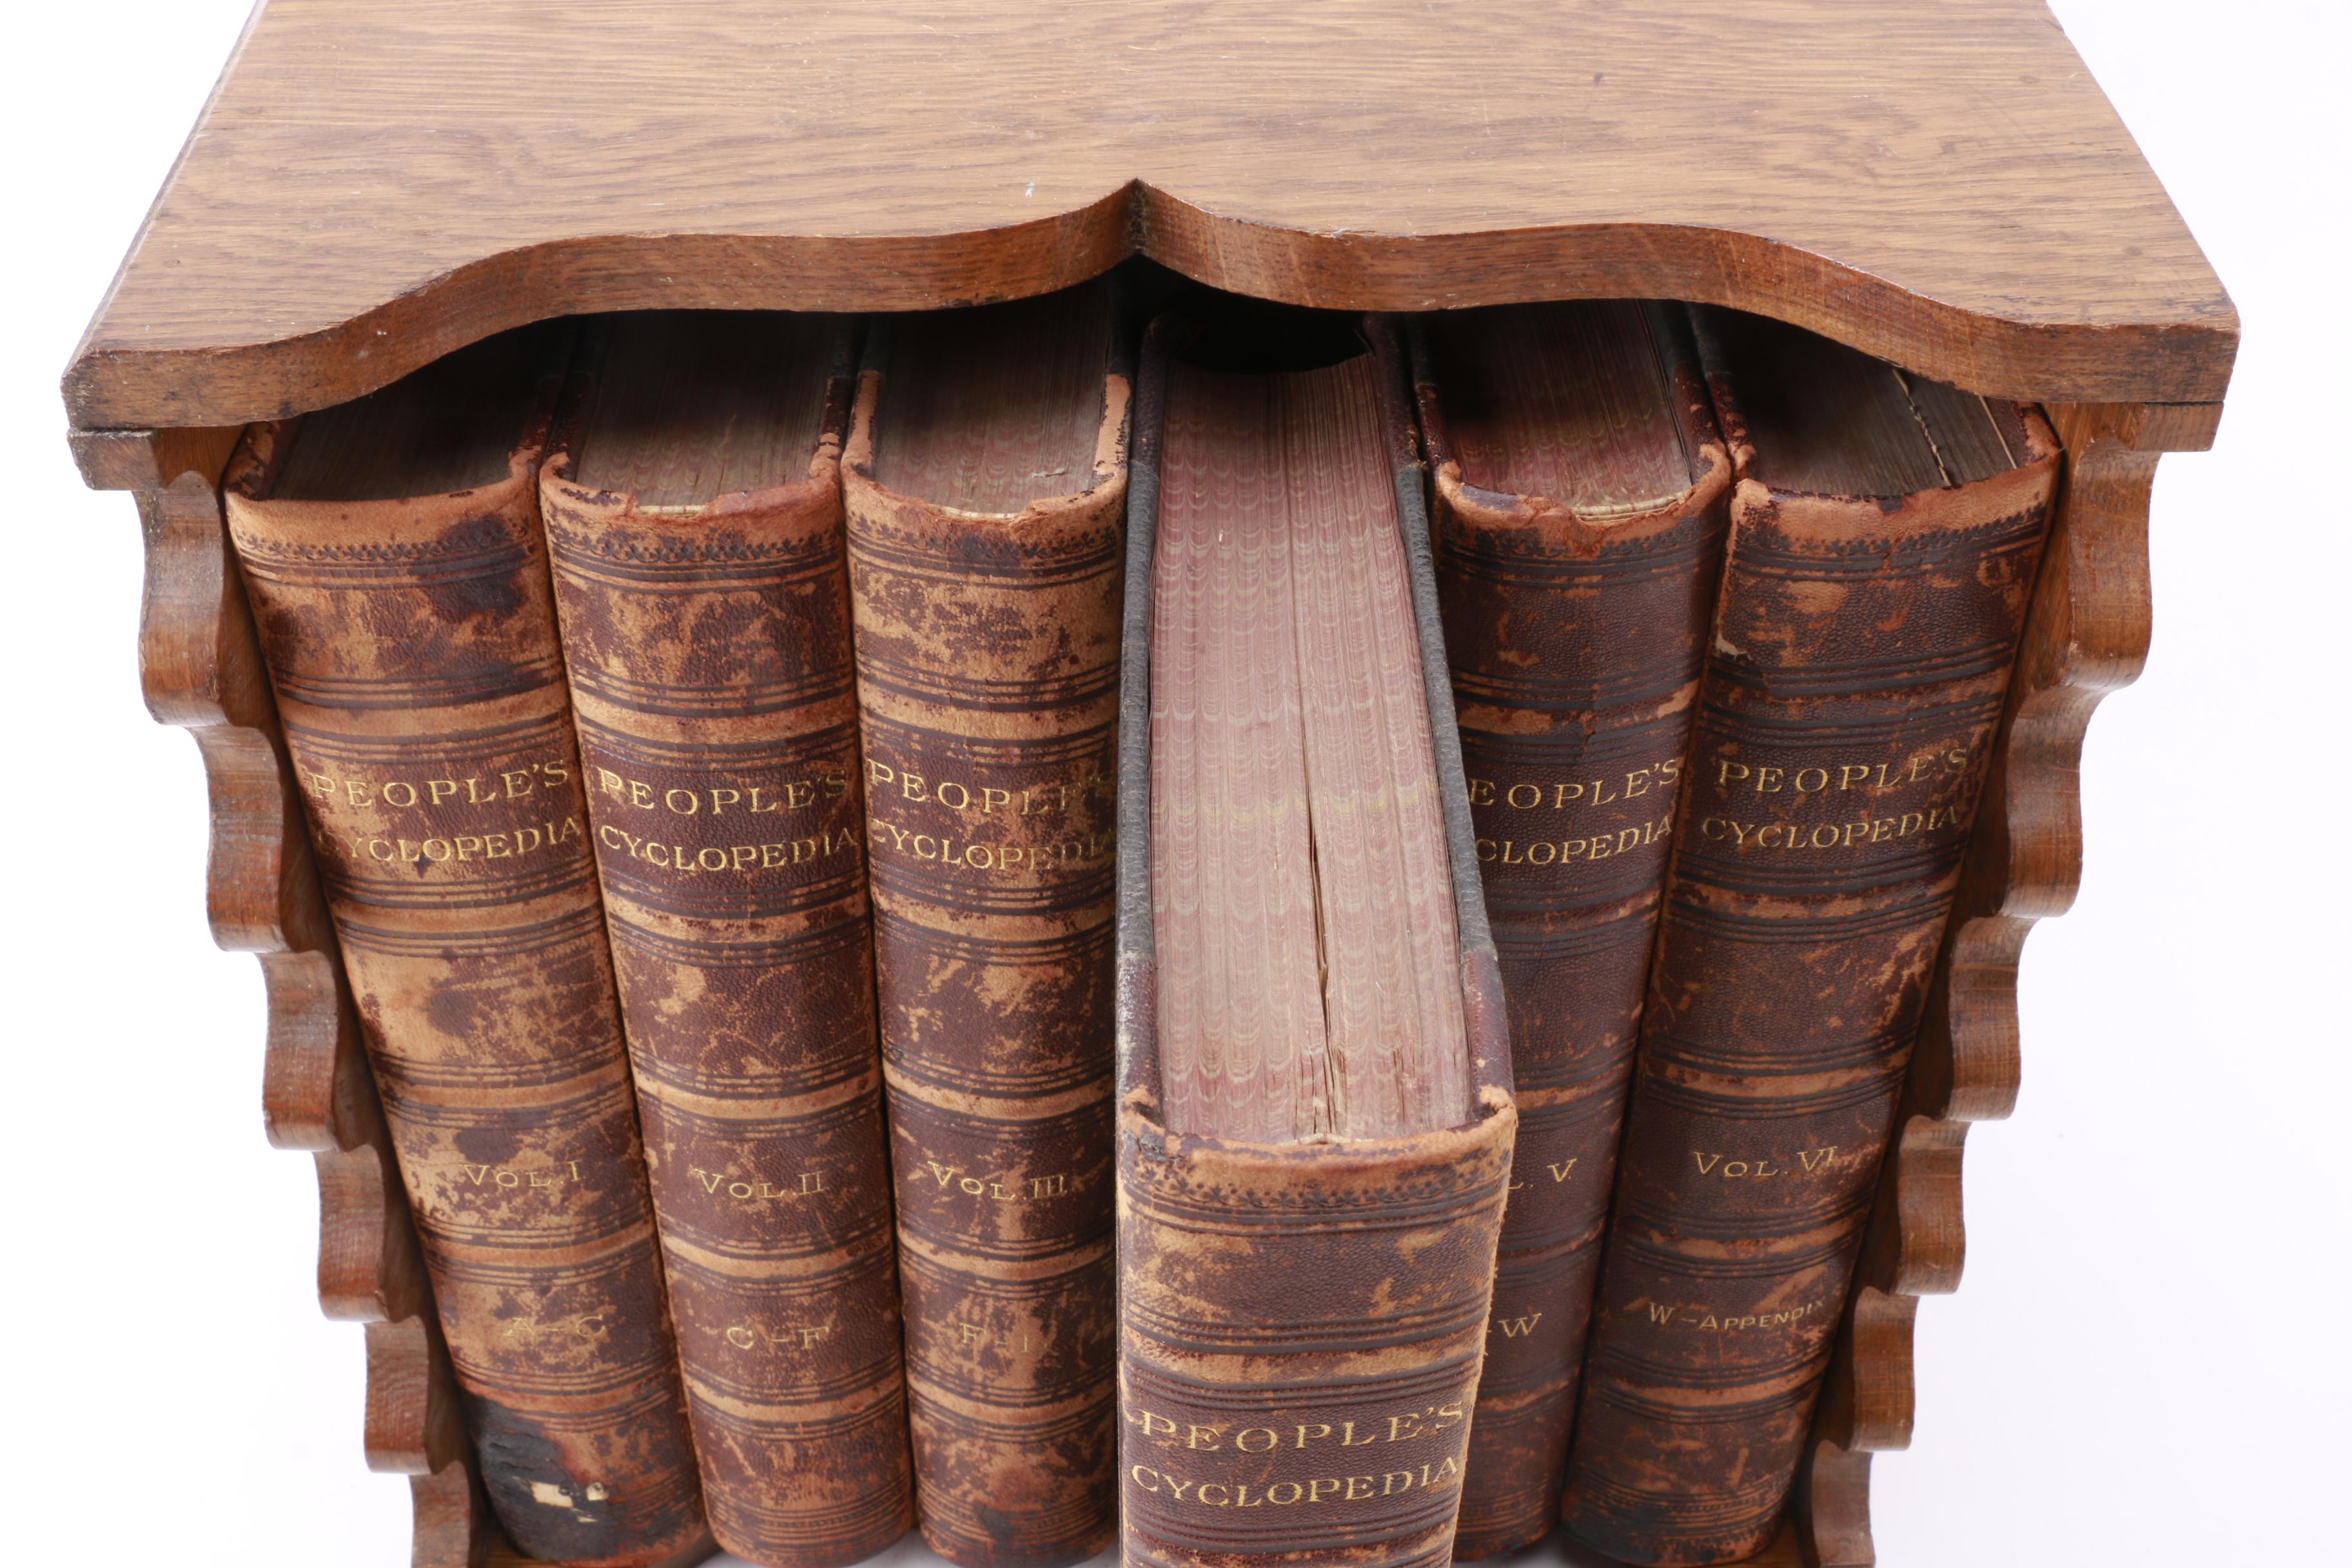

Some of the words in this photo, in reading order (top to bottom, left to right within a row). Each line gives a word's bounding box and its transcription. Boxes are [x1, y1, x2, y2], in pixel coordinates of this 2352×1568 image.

[309, 760, 569, 807] PEOPLE'S
[596, 766, 848, 815] PEOPLE'S
[1469, 758, 1679, 810] EOPLE'S
[1718, 748, 1968, 792] PEOPLE'S
[600, 825, 859, 872] CYCLOPEDIA
[1475, 815, 1673, 865] CLOPEDIA
[1702, 805, 1957, 848] CYCLOPEDIA
[567, 1160, 581, 1182] I
[1547, 1159, 1578, 1182] V
[1796, 1146, 1838, 1171] VI
[798, 1171, 830, 1195] II
[1030, 1174, 1068, 1199] III
[1139, 1400, 1464, 1453] PEOPLE'S
[1131, 1456, 1459, 1507] CYCLOPEDIA
